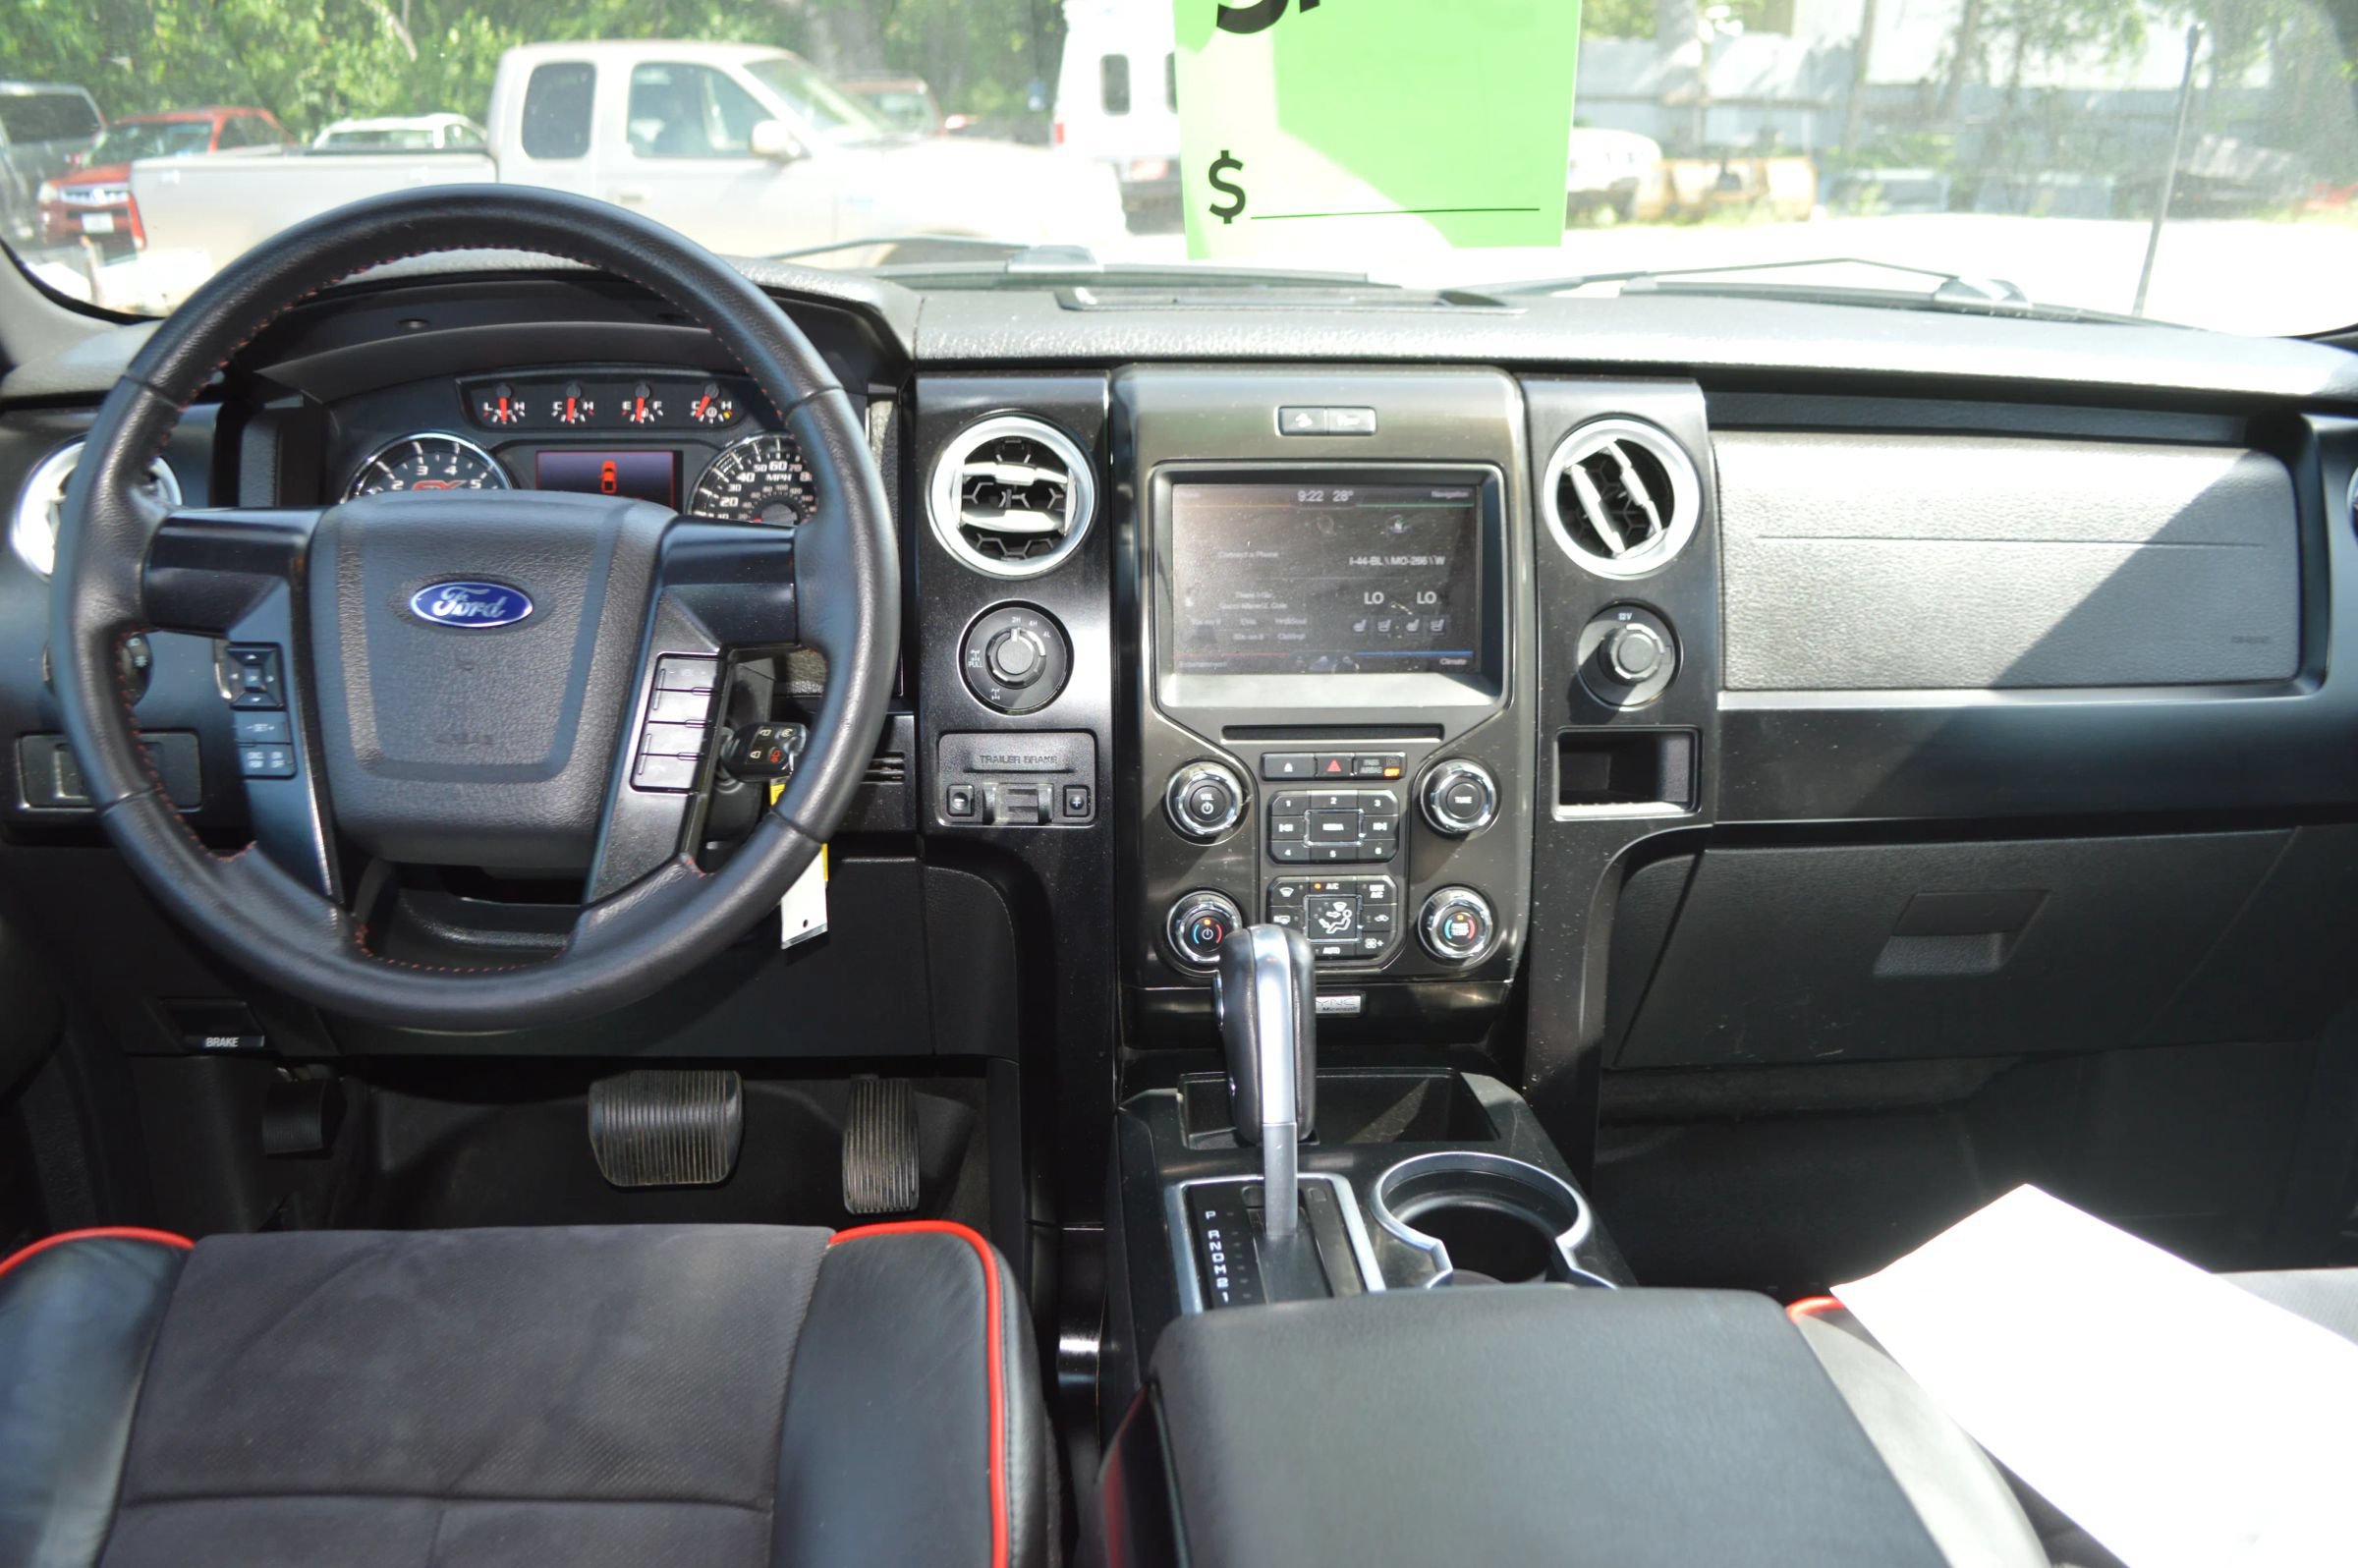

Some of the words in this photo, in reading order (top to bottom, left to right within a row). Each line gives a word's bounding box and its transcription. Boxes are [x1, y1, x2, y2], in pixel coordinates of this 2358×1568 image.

[1208, 149, 1246, 224] $
[483, 402, 492, 411] L
[514, 402, 525, 411] H
[553, 401, 563, 411] C
[583, 401, 593, 411] H
[622, 401, 632, 411] E
[652, 401, 662, 411] F
[721, 401, 732, 411] H
[417, 466, 428, 476] 3
[444, 466, 458, 476] 4
[753, 464, 767, 473] 50
[768, 461, 788, 472] 60
[789, 464, 803, 473] 70
[736, 473, 756, 482] 40
[392, 480, 405, 490] 2
[470, 478, 481, 489] 5
[728, 483, 742, 492] 30
[1297, 489, 1323, 502] 9:22
[720, 496, 739, 507] 20
[432, 587, 508, 618] Ford
[1364, 591, 1384, 604] LO
[1416, 591, 1437, 604] LO
[980, 755, 1021, 763] TRAILER
[205, 1036, 240, 1047] BRAKE
[1206, 1210, 1216, 1220] P
[1207, 1230, 1219, 1240] R
[1209, 1242, 1222, 1251] N
[1211, 1253, 1224, 1263] D
[1214, 1264, 1227, 1274] M
[1216, 1277, 1229, 1288] 2
[1222, 1292, 1229, 1303] 1
